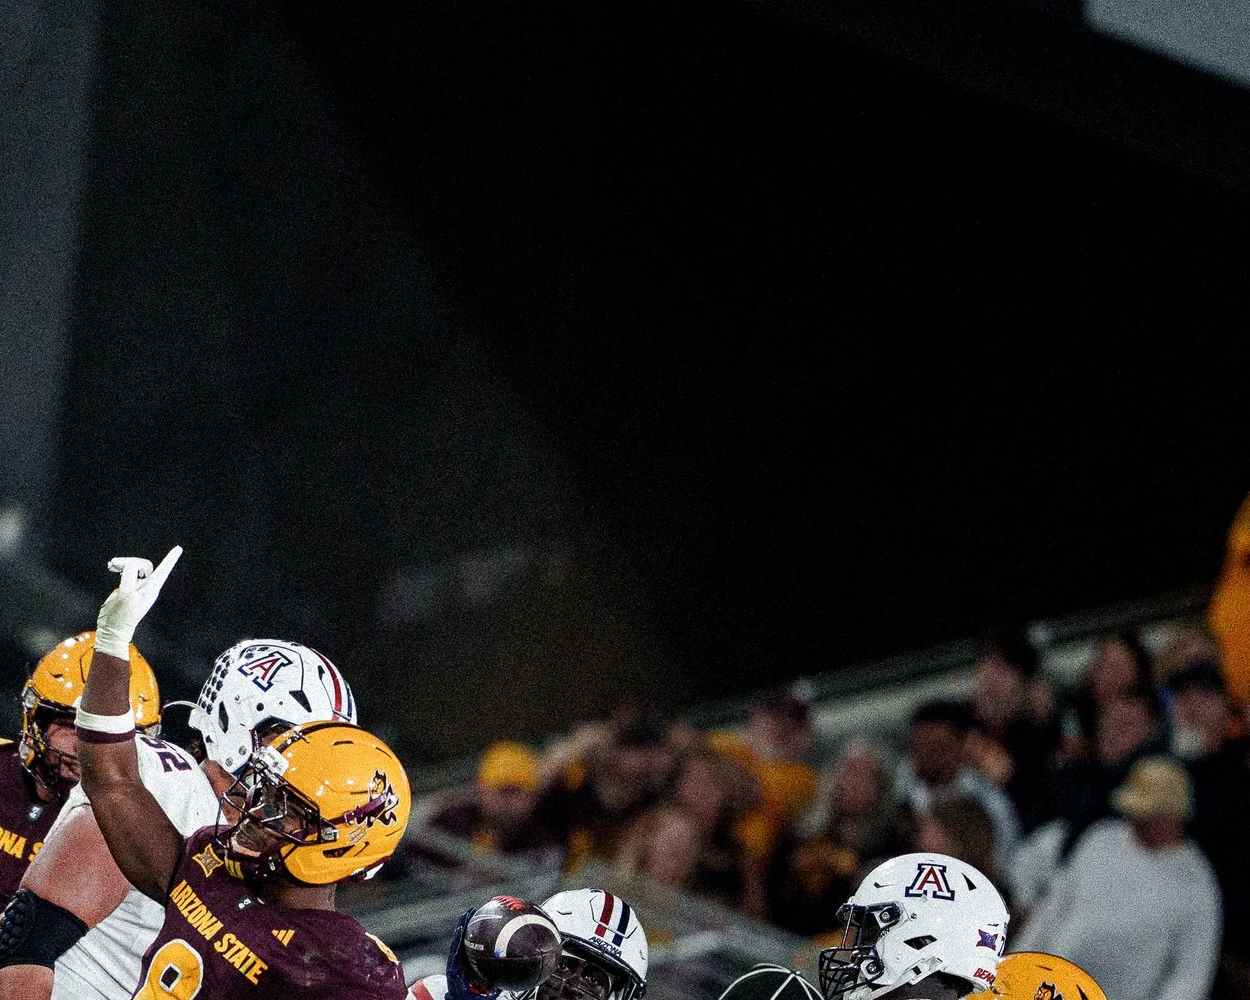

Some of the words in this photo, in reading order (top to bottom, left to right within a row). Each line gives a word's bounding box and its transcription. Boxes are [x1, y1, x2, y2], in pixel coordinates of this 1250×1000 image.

[237, 650, 294, 692] A
[904, 863, 956, 902] A
[169, 879, 225, 941] ARIZONA
[213, 932, 269, 986] STATE
